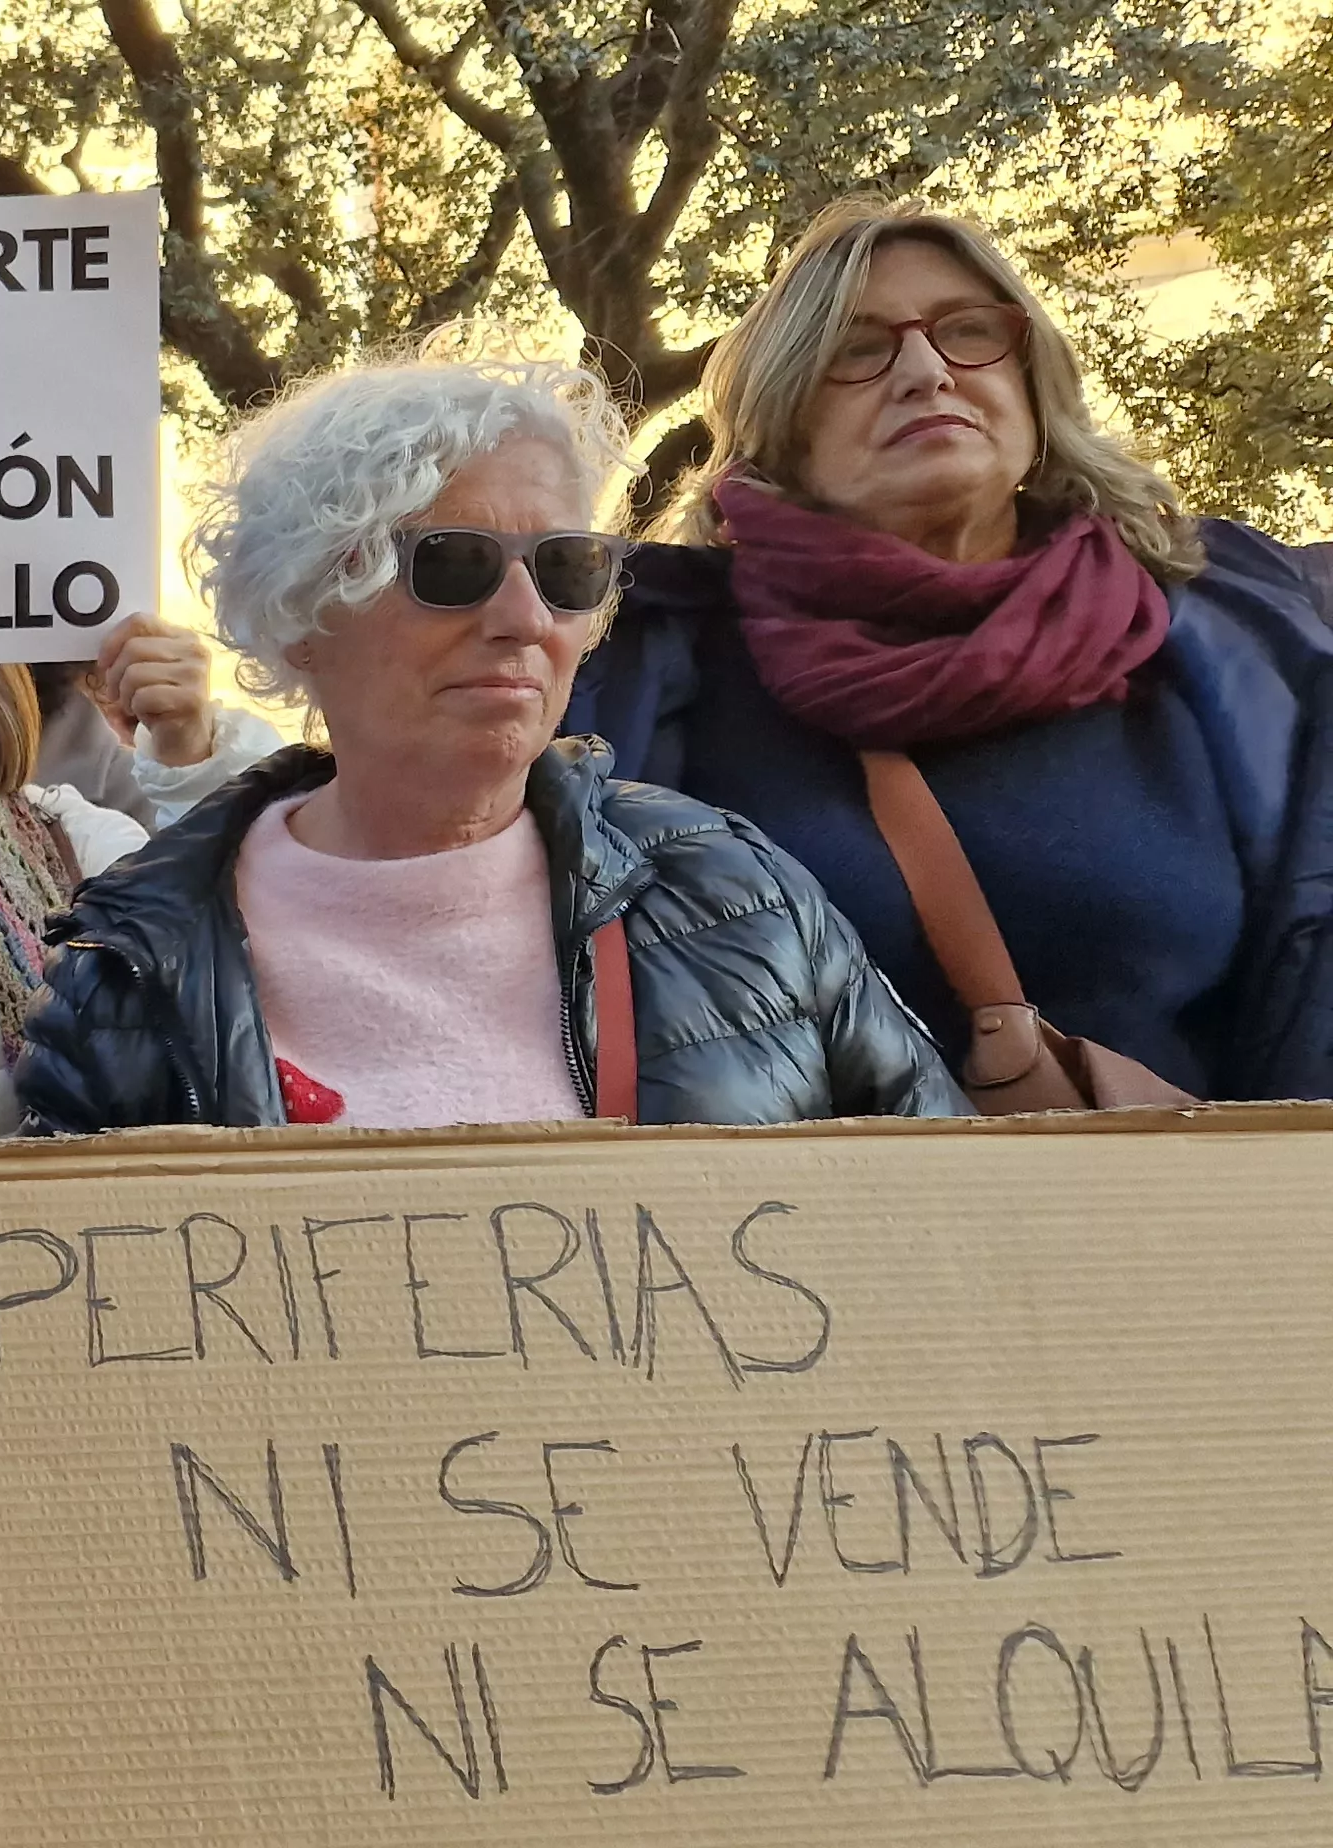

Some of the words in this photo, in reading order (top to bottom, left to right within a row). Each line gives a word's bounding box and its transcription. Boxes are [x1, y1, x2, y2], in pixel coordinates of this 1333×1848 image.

[169, 1438, 358, 1600] NI
[436, 1430, 641, 1598] SE
[731, 1425, 1125, 1589] VENDE
[363, 1641, 510, 1802] NI
[586, 1634, 748, 1796] SE
